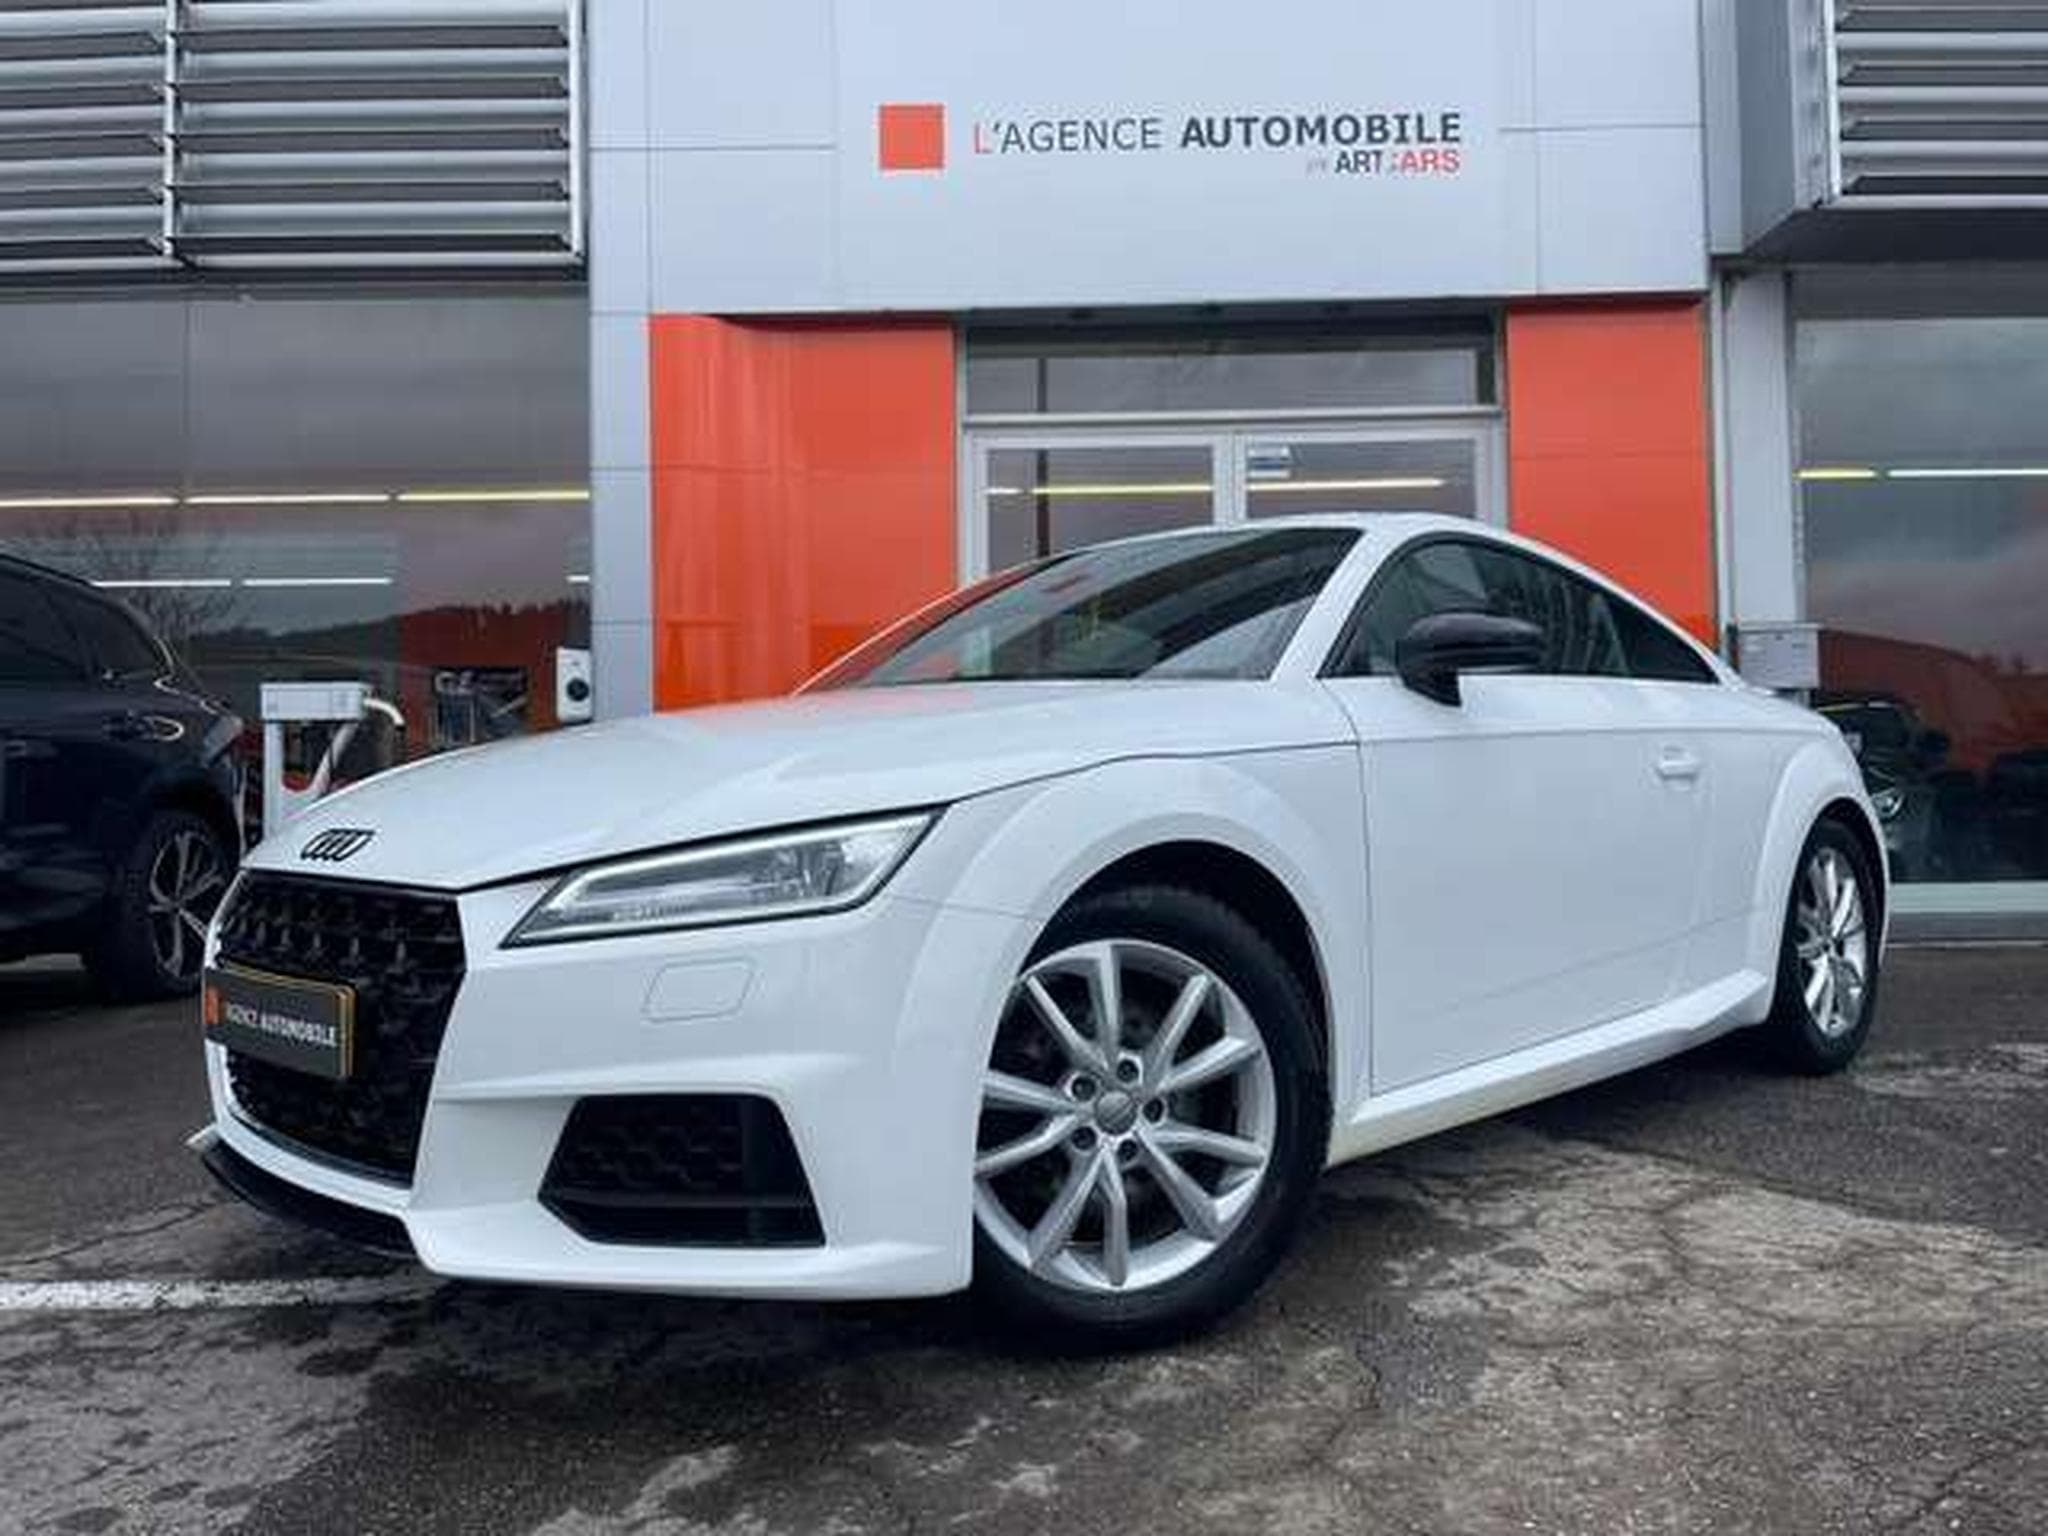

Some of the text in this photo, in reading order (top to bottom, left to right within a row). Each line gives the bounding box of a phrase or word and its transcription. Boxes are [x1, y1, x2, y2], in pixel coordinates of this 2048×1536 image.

[973, 112, 1462, 155] L'AGENCE AUTOMOBILE
[1334, 150, 1384, 174] ART
